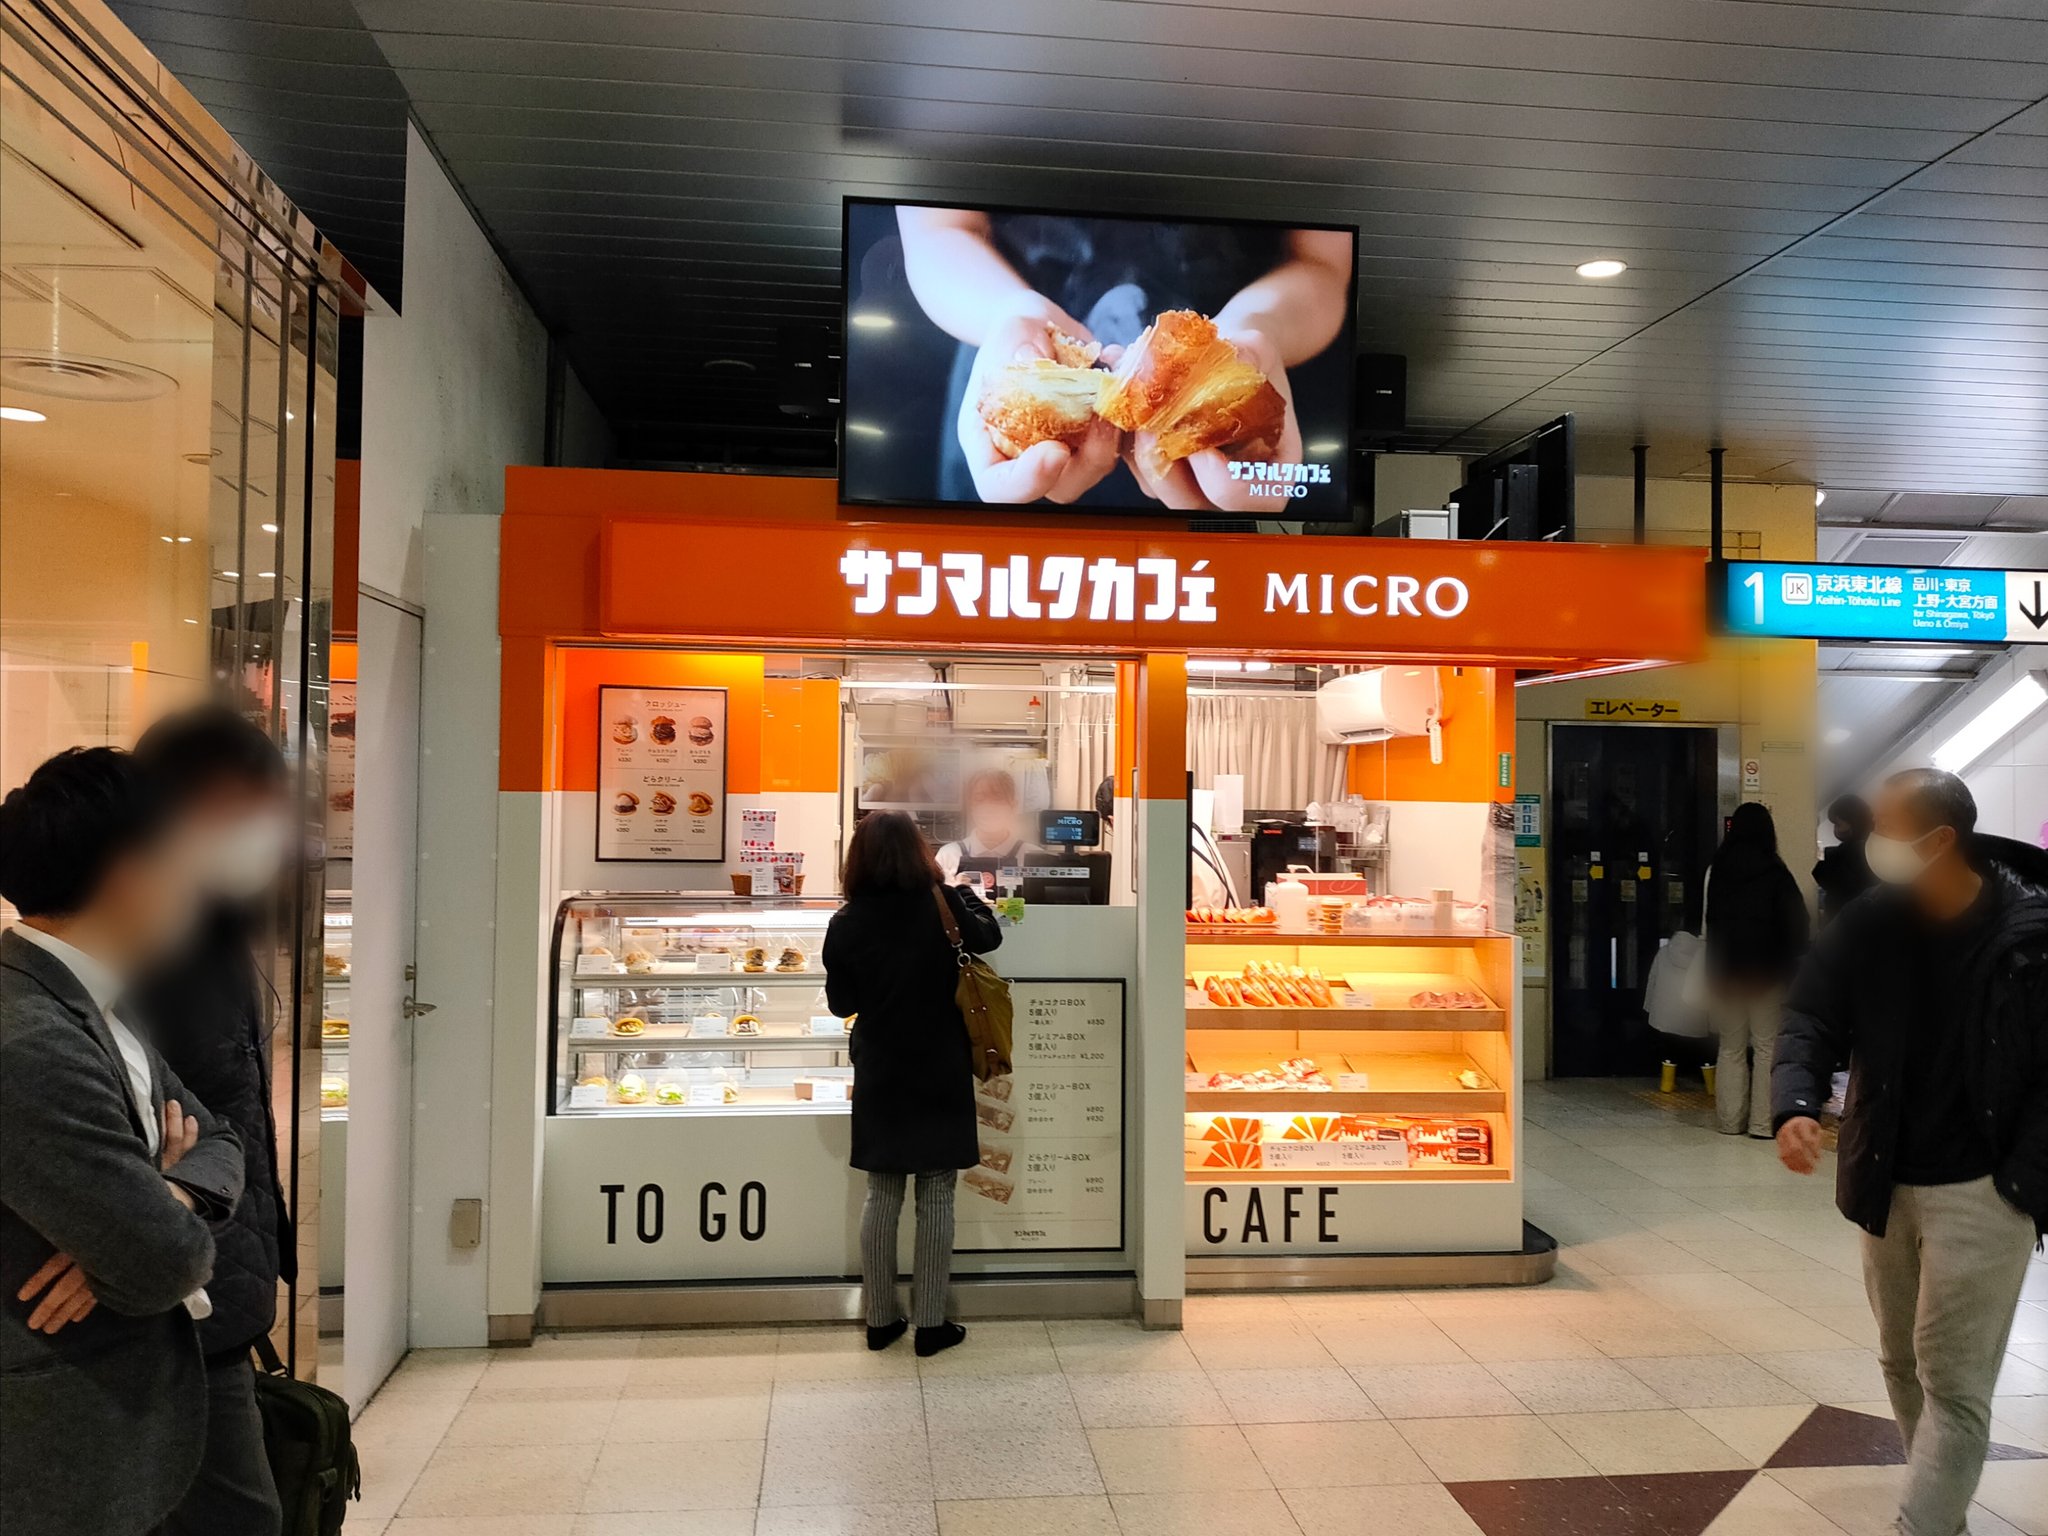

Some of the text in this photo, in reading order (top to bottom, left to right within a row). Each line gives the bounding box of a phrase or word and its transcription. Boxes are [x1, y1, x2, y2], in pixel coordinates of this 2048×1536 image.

[1227, 461, 1331, 483] サンマルクカフェ
[1249, 484, 1308, 498] MICRO
[840, 549, 1217, 622] サンマルクカフェ
[1789, 582, 1805, 595] JK
[1816, 574, 1903, 594] 京浜東北線
[1263, 572, 1470, 618] MICRO
[1743, 571, 1765, 625] 1
[1881, 596, 1902, 607] Line
[1913, 609, 1924, 617] for
[1913, 619, 1934, 627] Ueno
[1935, 619, 1942, 628] &
[645, 700, 687, 708] クロッシュー
[1589, 701, 1679, 718] エレベーター
[1029, 999, 1086, 1007] チョコクロBOX
[1029, 1033, 1086, 1041] プレミアムBOX
[1029, 1083, 1091, 1091] クロッシューBOX
[1028, 1153, 1090, 1161] どらクリームBOX
[600, 1180, 767, 1244] TO GO
[1203, 1187, 1339, 1244] CAFE
